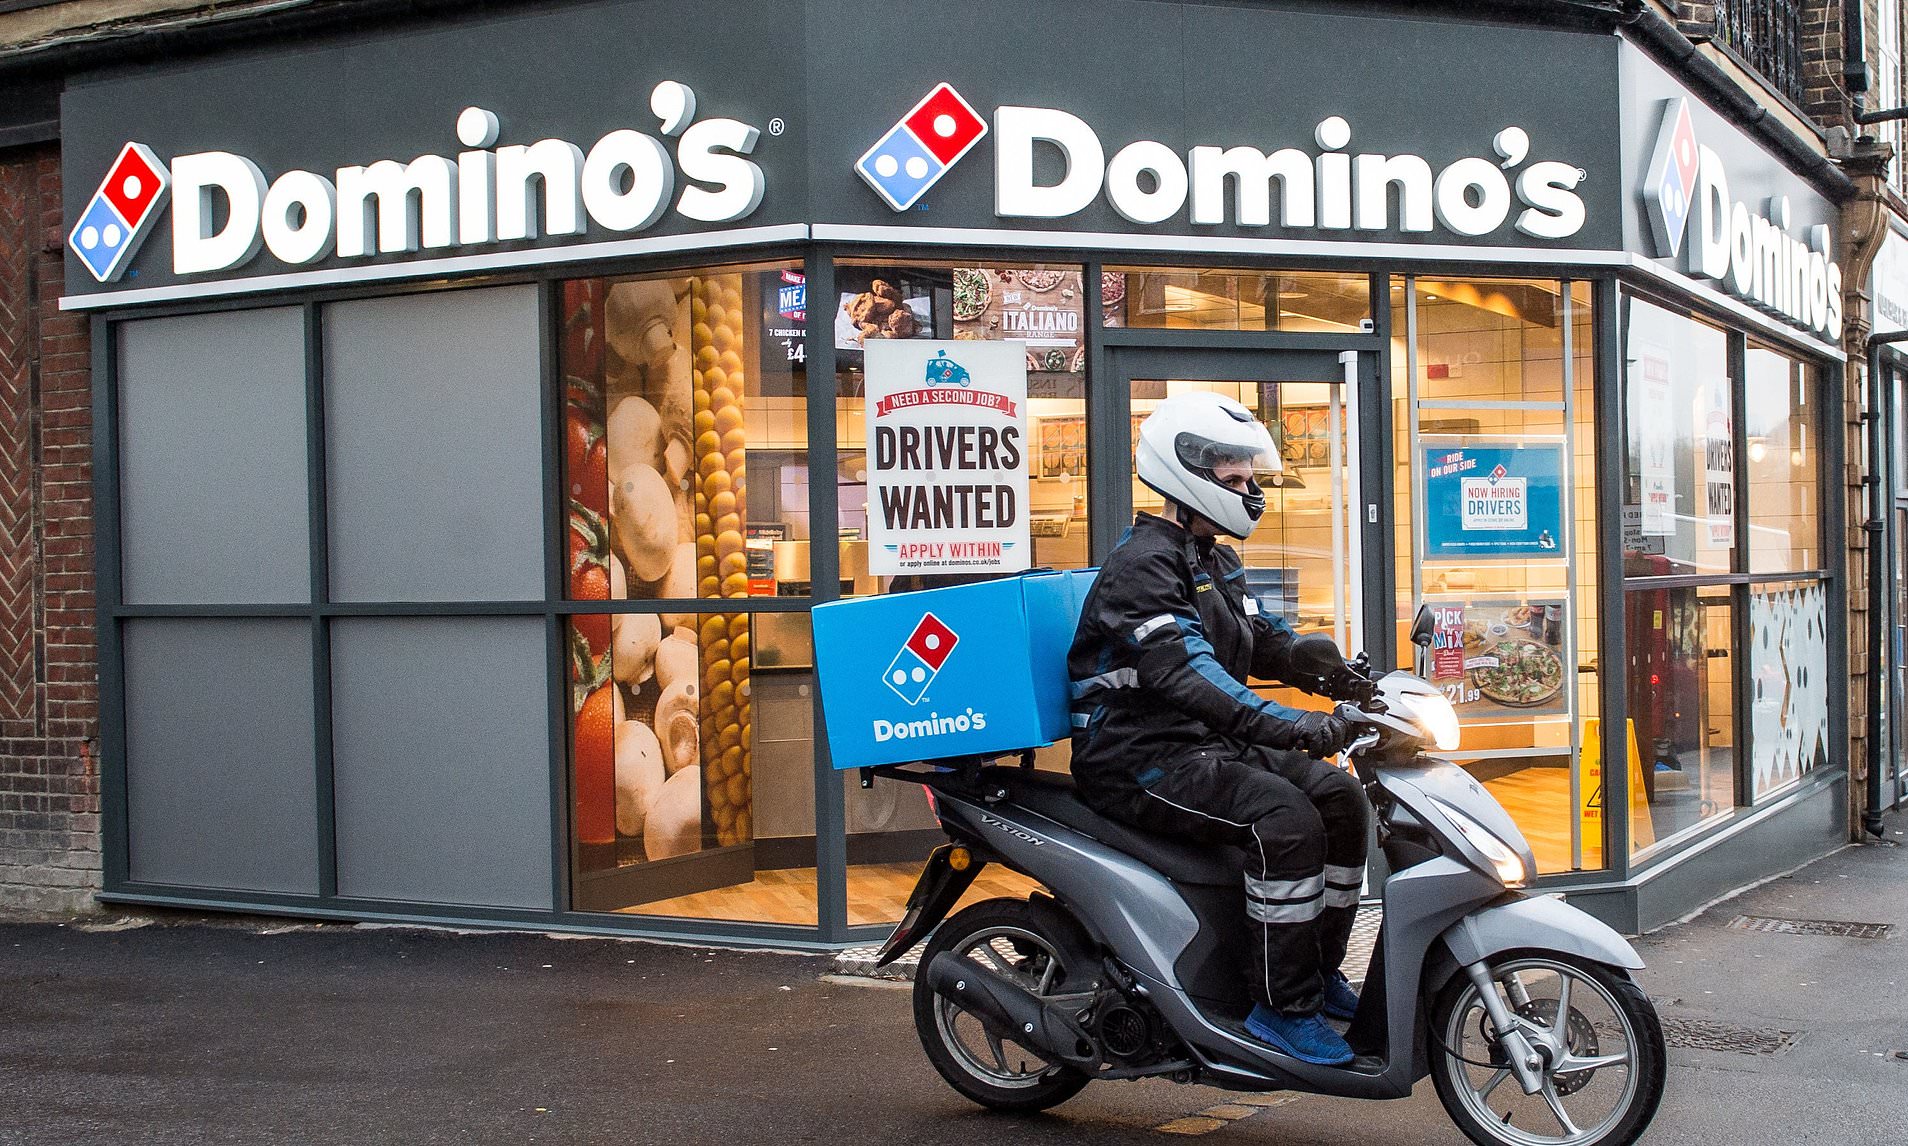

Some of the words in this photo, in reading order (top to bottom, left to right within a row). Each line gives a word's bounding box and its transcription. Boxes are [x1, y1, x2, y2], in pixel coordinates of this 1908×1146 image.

[171, 80, 764, 275] Domino's
[994, 104, 1587, 239] Domino's
[1695, 143, 1843, 340] Domino's
[785, 272, 801, 284] MAKE
[793, 310, 802, 319] OF
[1002, 311, 1078, 331] ITALIANO
[768, 328, 774, 337] 7
[774, 328, 801, 337] CHICKEN
[891, 392, 919, 407] NEED
[922, 391, 931, 404] A
[931, 390, 974, 404] SECOND
[976, 393, 1001, 407] JOB?
[875, 425, 1020, 471] DRIVERS
[1446, 451, 1464, 464] RIDE
[1706, 437, 1732, 473] DRIVERS
[1430, 467, 1441, 478] ON
[1443, 463, 1459, 474] OUR
[1459, 458, 1477, 471] SIDE
[1468, 487, 1488, 499] NOW
[1491, 487, 1520, 498] HIRING
[1707, 482, 1731, 516] WANTED
[878, 484, 1016, 530] WANTED
[1468, 500, 1521, 515] DRIVERS
[900, 543, 944, 559] APPLY
[949, 542, 1000, 557] WITHIN
[907, 560, 922, 568] apply
[923, 559, 940, 567] online
[948, 558, 1001, 567] dominos.co.uk/jobs
[1434, 608, 1462, 627] PICK
[873, 707, 987, 743] Domino's
[1584, 810, 1598, 818] WET
[980, 814, 1047, 847] VISION
